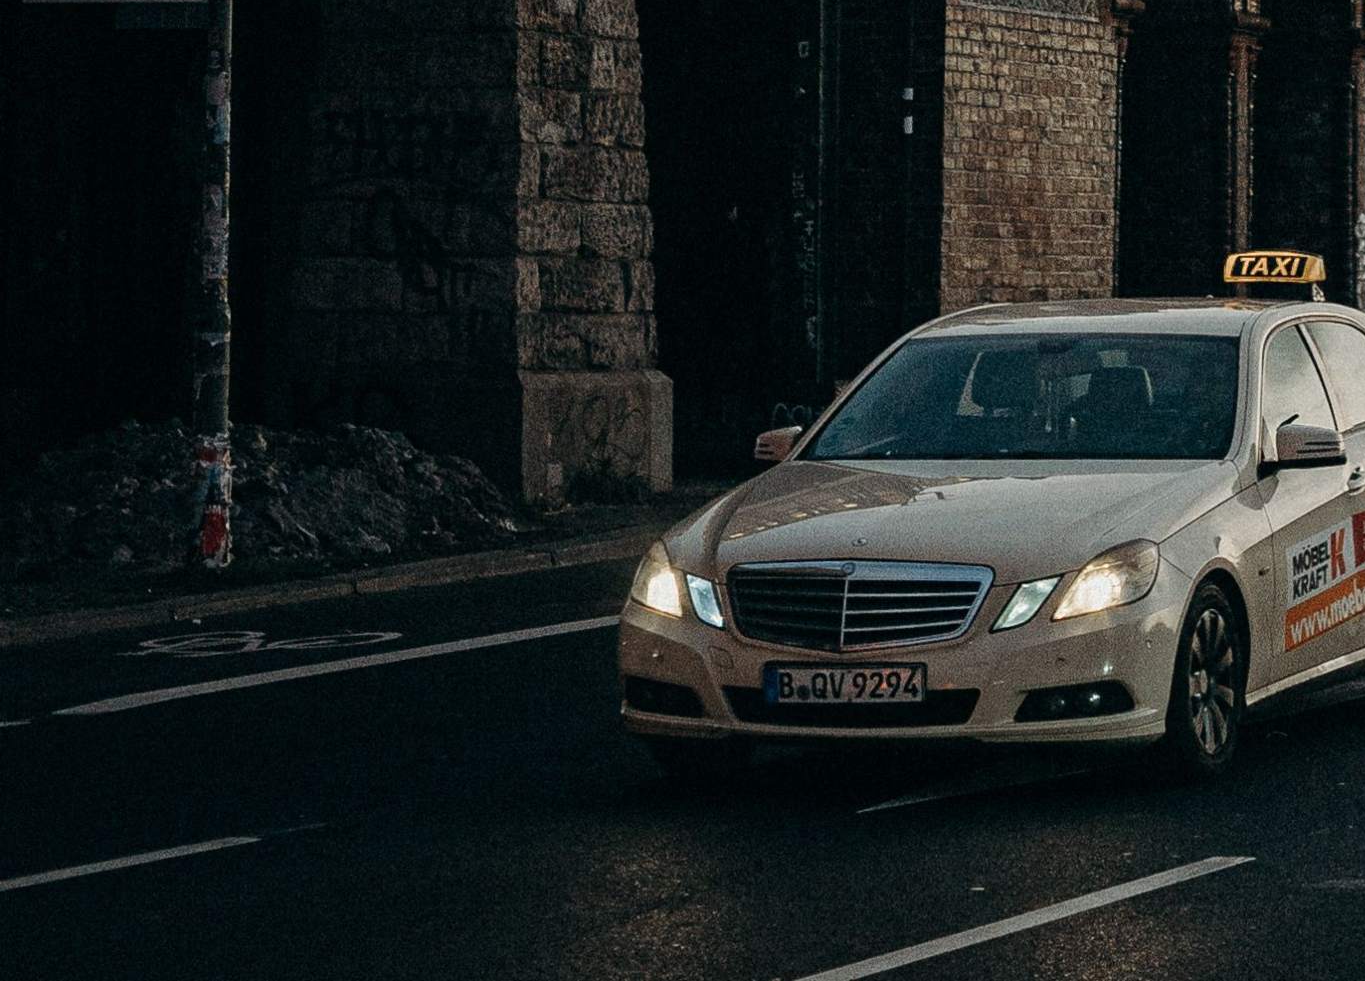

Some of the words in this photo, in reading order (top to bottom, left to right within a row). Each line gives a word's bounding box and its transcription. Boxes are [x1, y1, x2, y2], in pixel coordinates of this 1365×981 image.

[1239, 256, 1300, 276] TAXI
[1292, 539, 1330, 576] MÖBEL
[1292, 563, 1329, 600] KRAFT
[779, 671, 794, 699] B
[811, 672, 845, 699] QV
[852, 670, 919, 699] 9294
